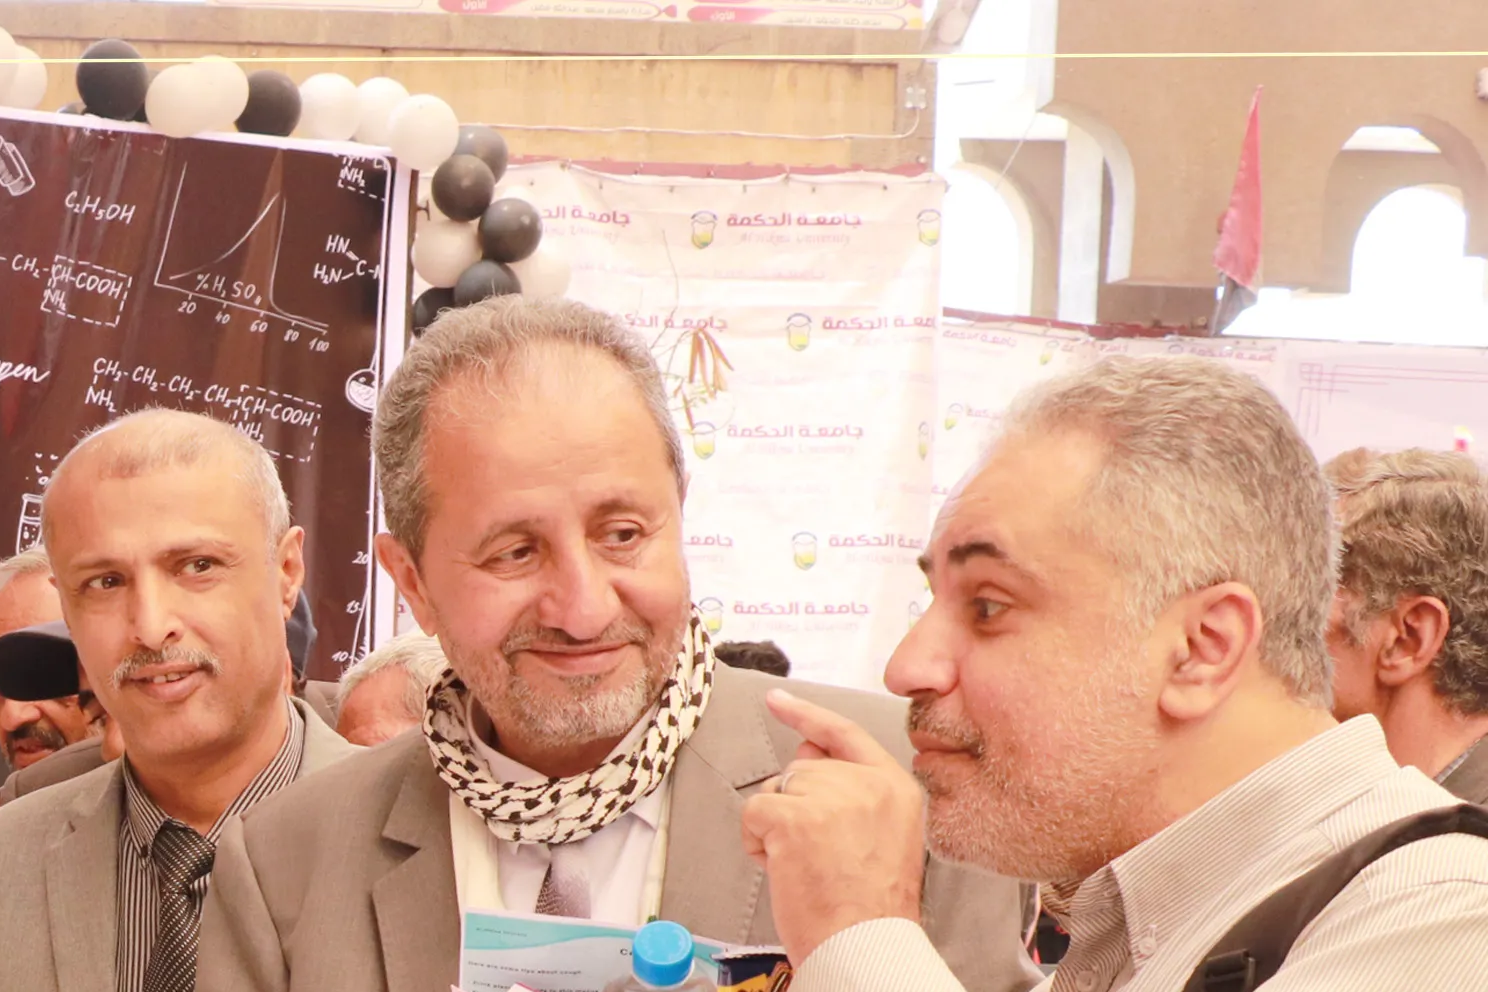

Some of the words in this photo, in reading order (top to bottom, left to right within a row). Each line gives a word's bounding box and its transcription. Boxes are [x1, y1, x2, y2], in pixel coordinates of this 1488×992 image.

[571, 205, 632, 226] جامعة
[726, 212, 793, 228] الحكمة
[796, 212, 863, 229] جامعة
[178, 301, 197, 314] 20
[215, 311, 231, 325] 40
[250, 320, 268, 333] 60
[283, 329, 300, 343] 80
[308, 336, 330, 352] 100
[663, 316, 729, 333] جامعة
[821, 316, 888, 332] الحكمة
[726, 424, 794, 438] الحكمة
[798, 424, 864, 440] جامعة
[828, 534, 895, 548] الحكمة
[733, 601, 799, 616] الحكمة
[804, 601, 870, 616] جامعة
